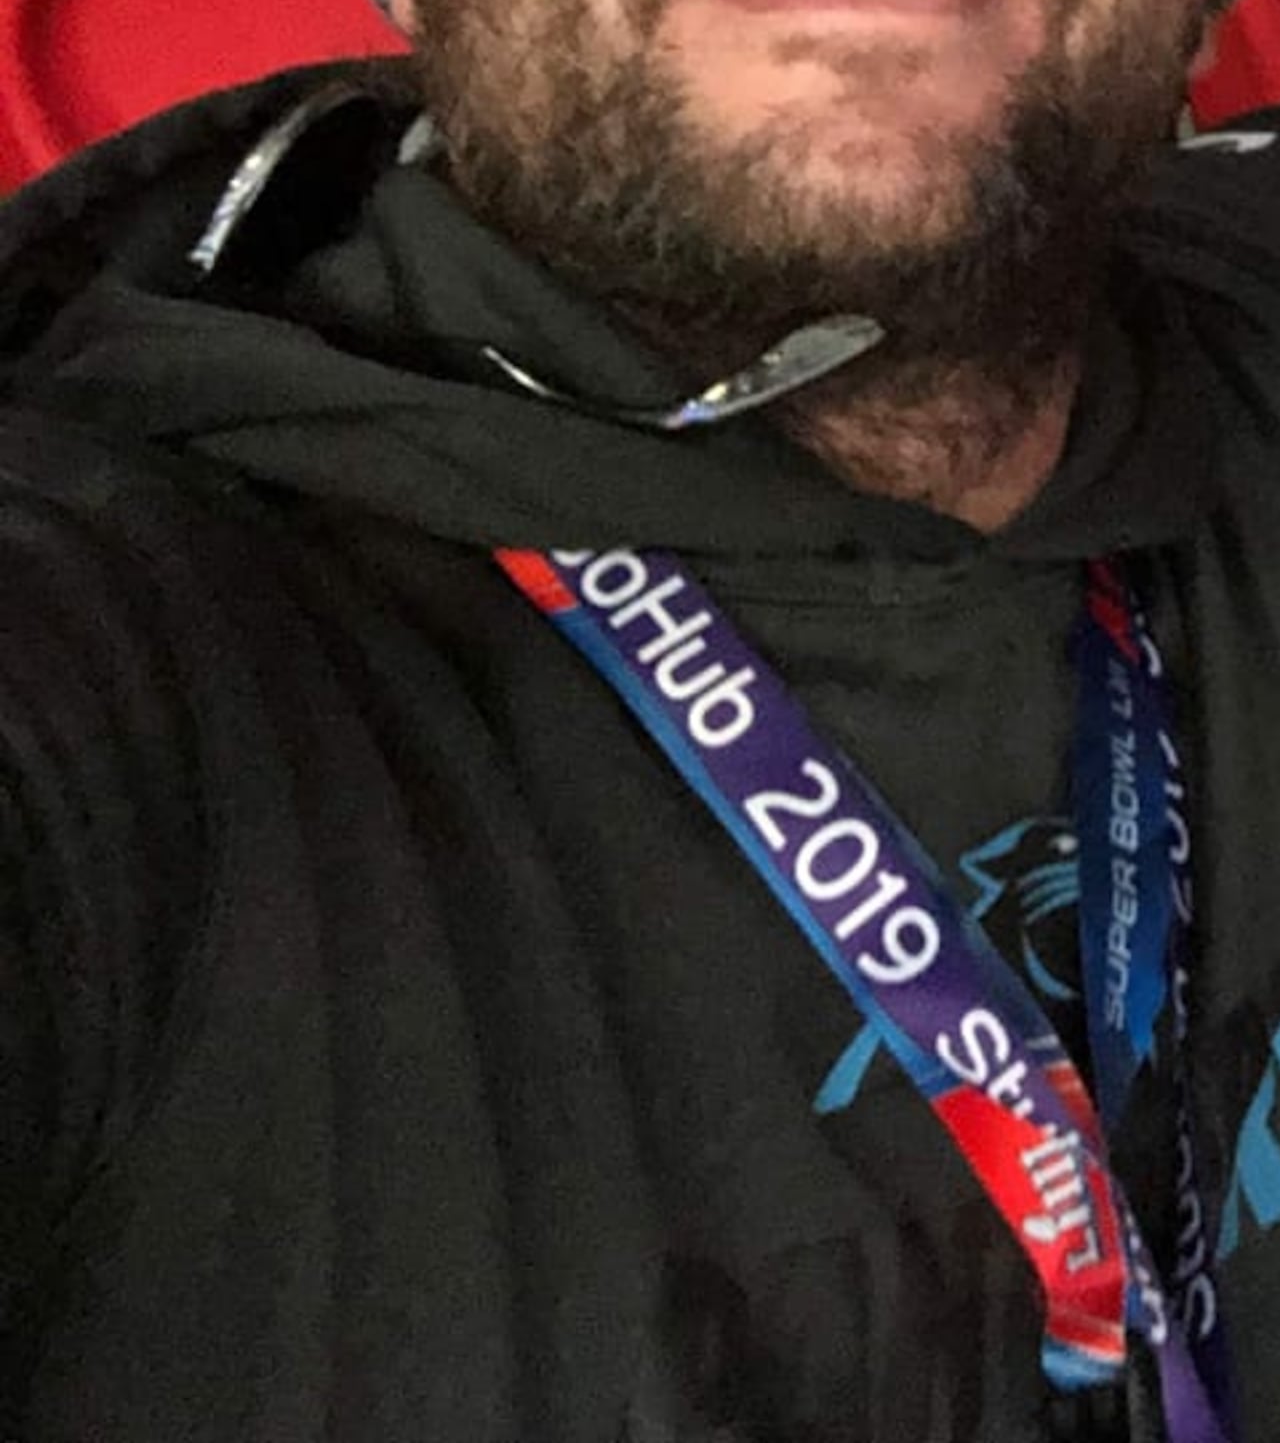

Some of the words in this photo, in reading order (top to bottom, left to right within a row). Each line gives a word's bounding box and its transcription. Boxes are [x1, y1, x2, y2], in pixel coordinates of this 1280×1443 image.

[743, 758, 941, 985] 2019
[1109, 730, 1141, 854] BOWL
[1103, 857, 1140, 1031] SUPER
